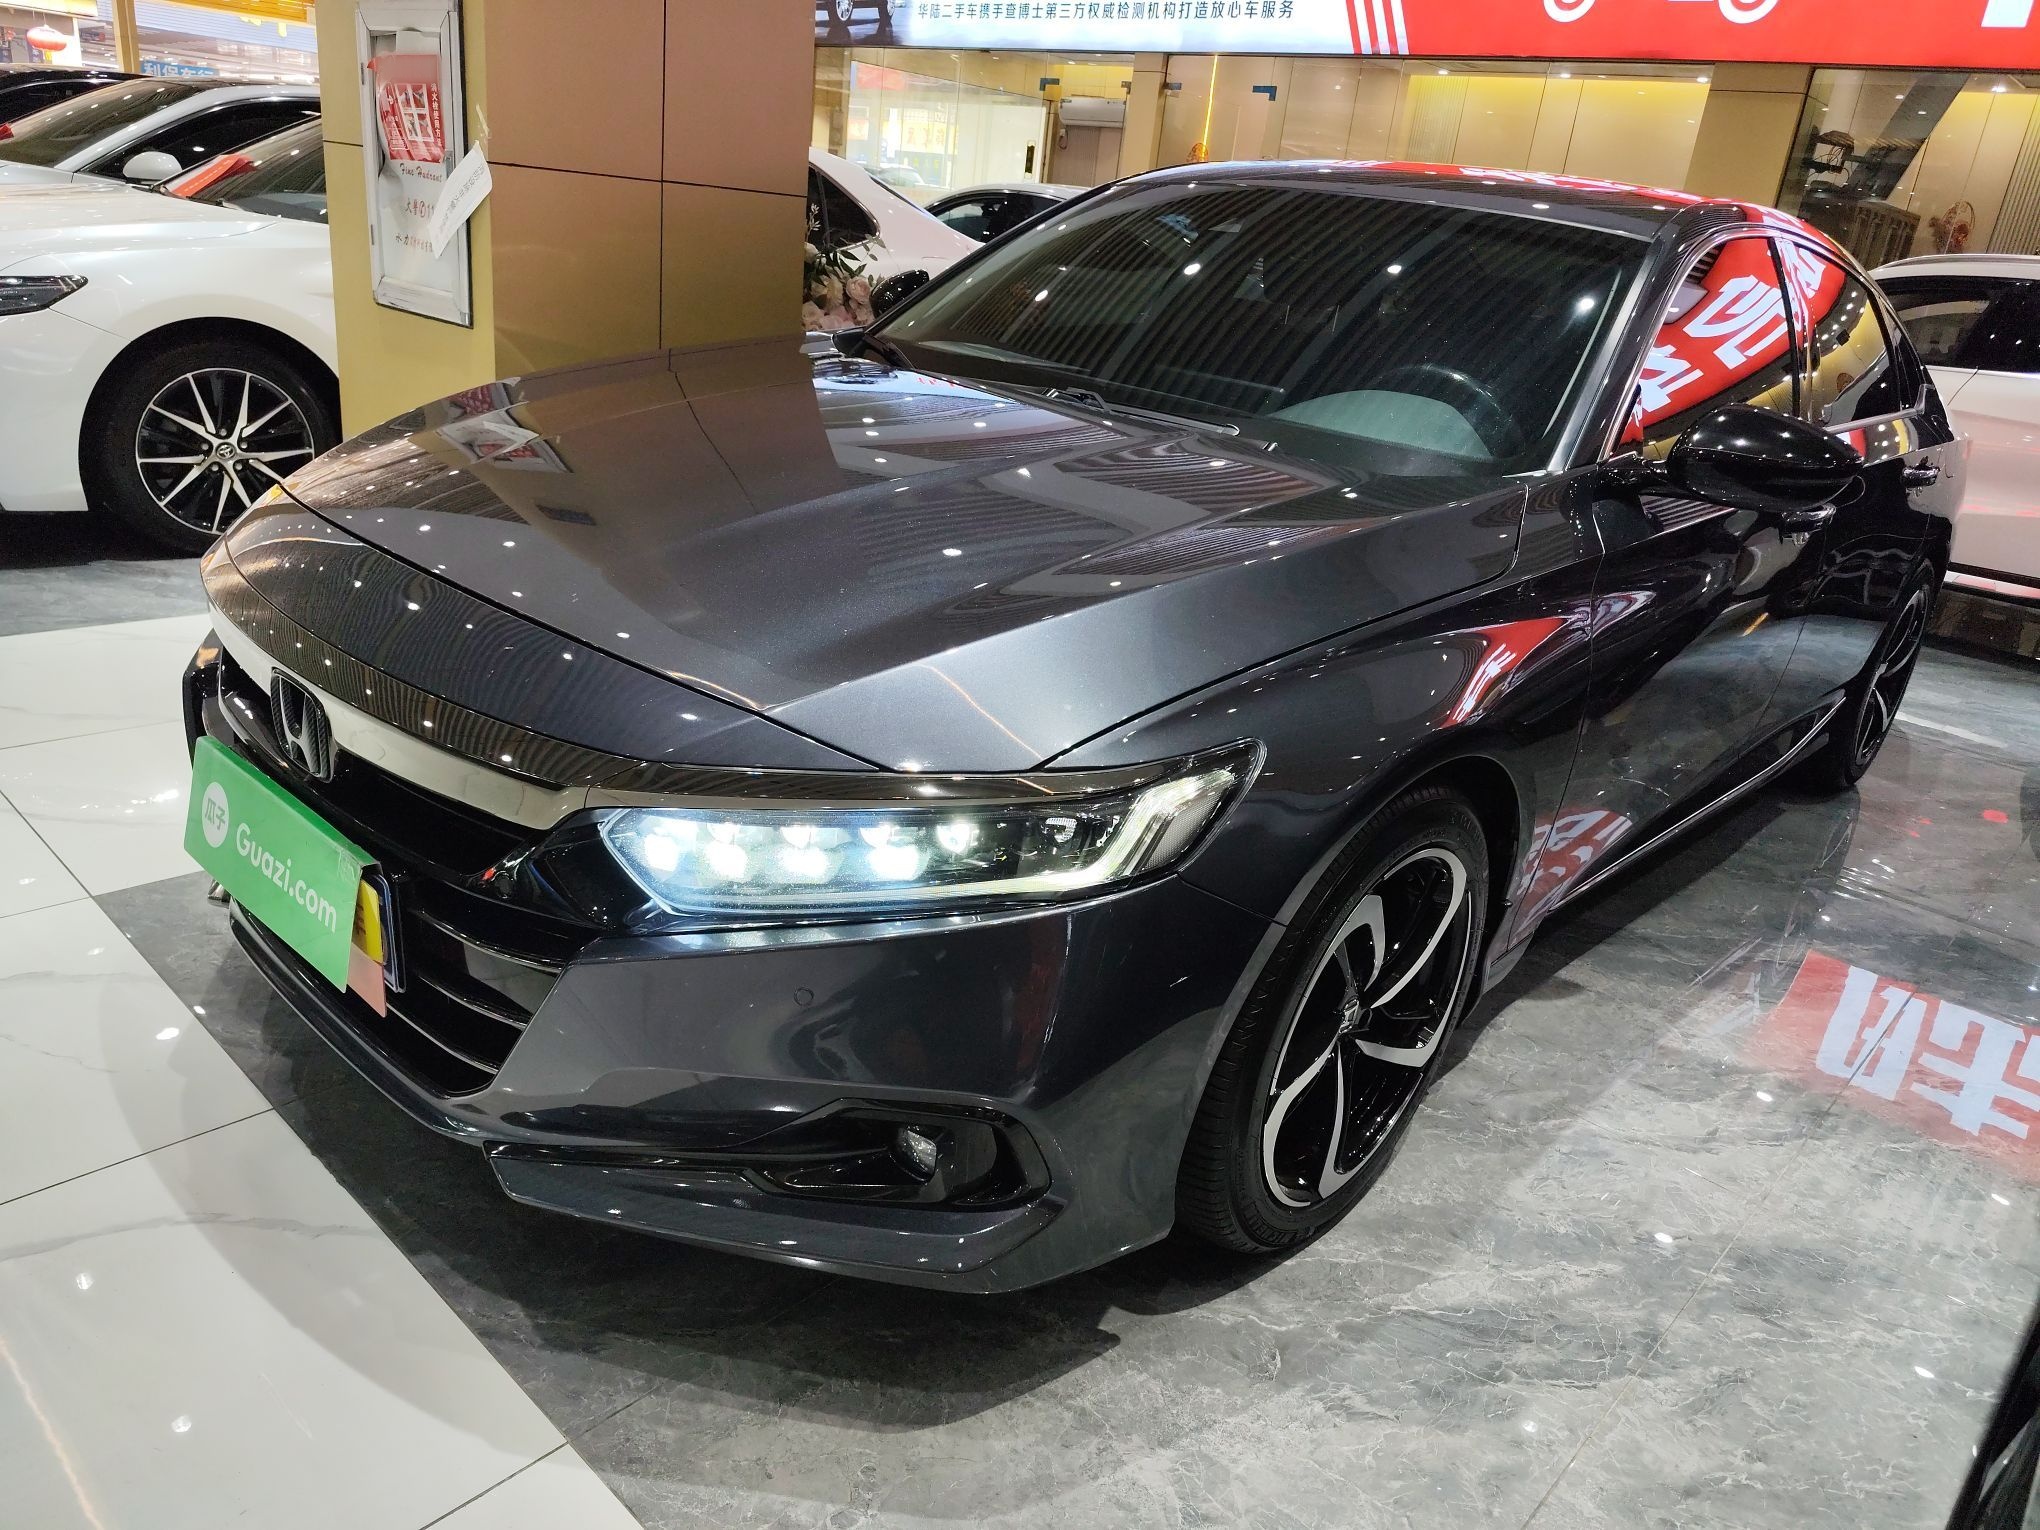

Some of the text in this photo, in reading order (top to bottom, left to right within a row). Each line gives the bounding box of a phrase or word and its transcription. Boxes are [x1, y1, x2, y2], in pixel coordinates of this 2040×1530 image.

[917, 0, 1295, 20] 华陆二手车携手查博士第三方权威检测机构打造放心车服务
[203, 802, 227, 832] 瓜子
[235, 822, 338, 934] Guazi.com
